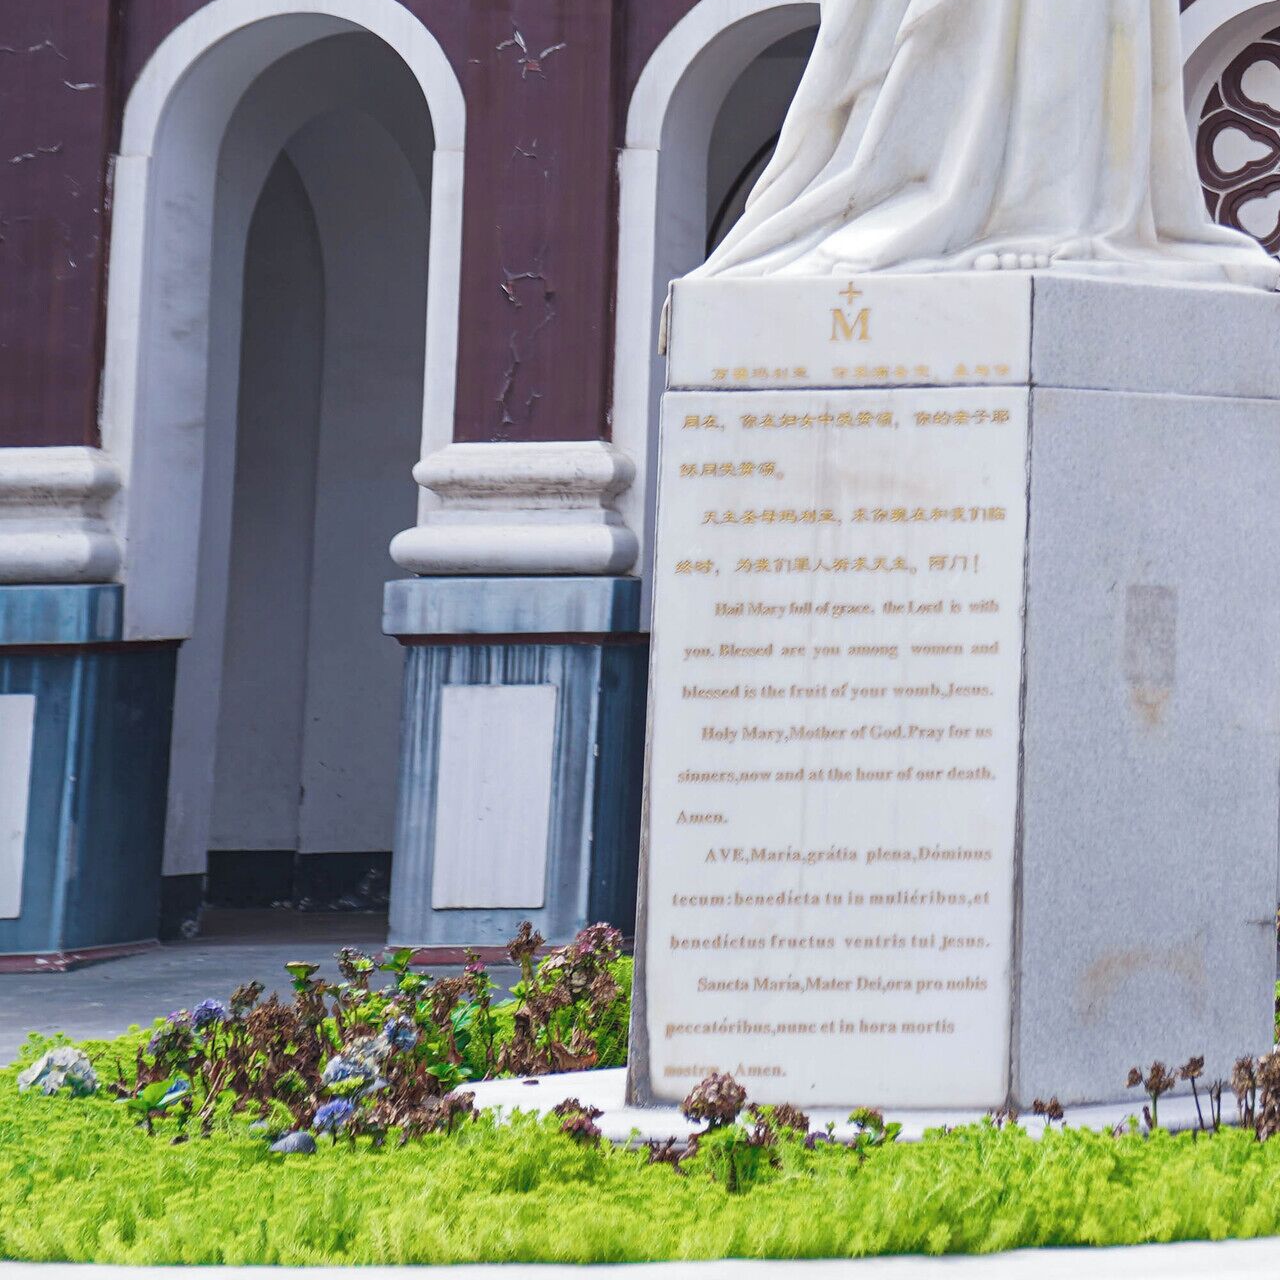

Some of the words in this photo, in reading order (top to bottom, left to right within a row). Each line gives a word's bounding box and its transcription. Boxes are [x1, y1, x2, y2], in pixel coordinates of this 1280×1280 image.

[829, 308, 872, 342] M
[715, 602, 744, 618] Hail
[748, 601, 787, 618] Mary
[790, 601, 813, 615] full
[816, 602, 830, 615] of
[883, 601, 904, 615] the
[907, 600, 943, 614] Lord
[950, 600, 961, 614] is
[969, 599, 999, 613] with
[719, 642, 773, 658] Blessed
[781, 645, 806, 657] are
[814, 646, 840, 659] you
[848, 645, 898, 659] among
[911, 644, 963, 655] women
[971, 642, 999, 655] and
[682, 685, 739, 699] blessed
[744, 685, 757, 700] is
[761, 685, 786, 698] the
[790, 685, 827, 698] fruit
[831, 683, 848, 697] of
[851, 687, 887, 700] your
[702, 726, 737, 744] Holy
[851, 725, 865, 739] of
[949, 725, 971, 738] for
[976, 728, 992, 738] us
[776, 767, 805, 782] and
[808, 769, 825, 782] at
[828, 768, 854, 782] the
[857, 767, 893, 781] hour
[897, 767, 913, 781] of
[916, 770, 944, 781] our
[677, 810, 728, 824] Amen.
[825, 893, 843, 906] tu
[848, 891, 864, 905] in
[770, 934, 835, 949] fructus
[845, 934, 906, 948] ventris
[911, 934, 935, 948] tui
[698, 977, 749, 992] Sancta
[916, 979, 943, 994] pro
[820, 1021, 836, 1034] et
[839, 1019, 855, 1034] in
[859, 1018, 897, 1034] hora
[734, 1063, 786, 1079] Amen.
